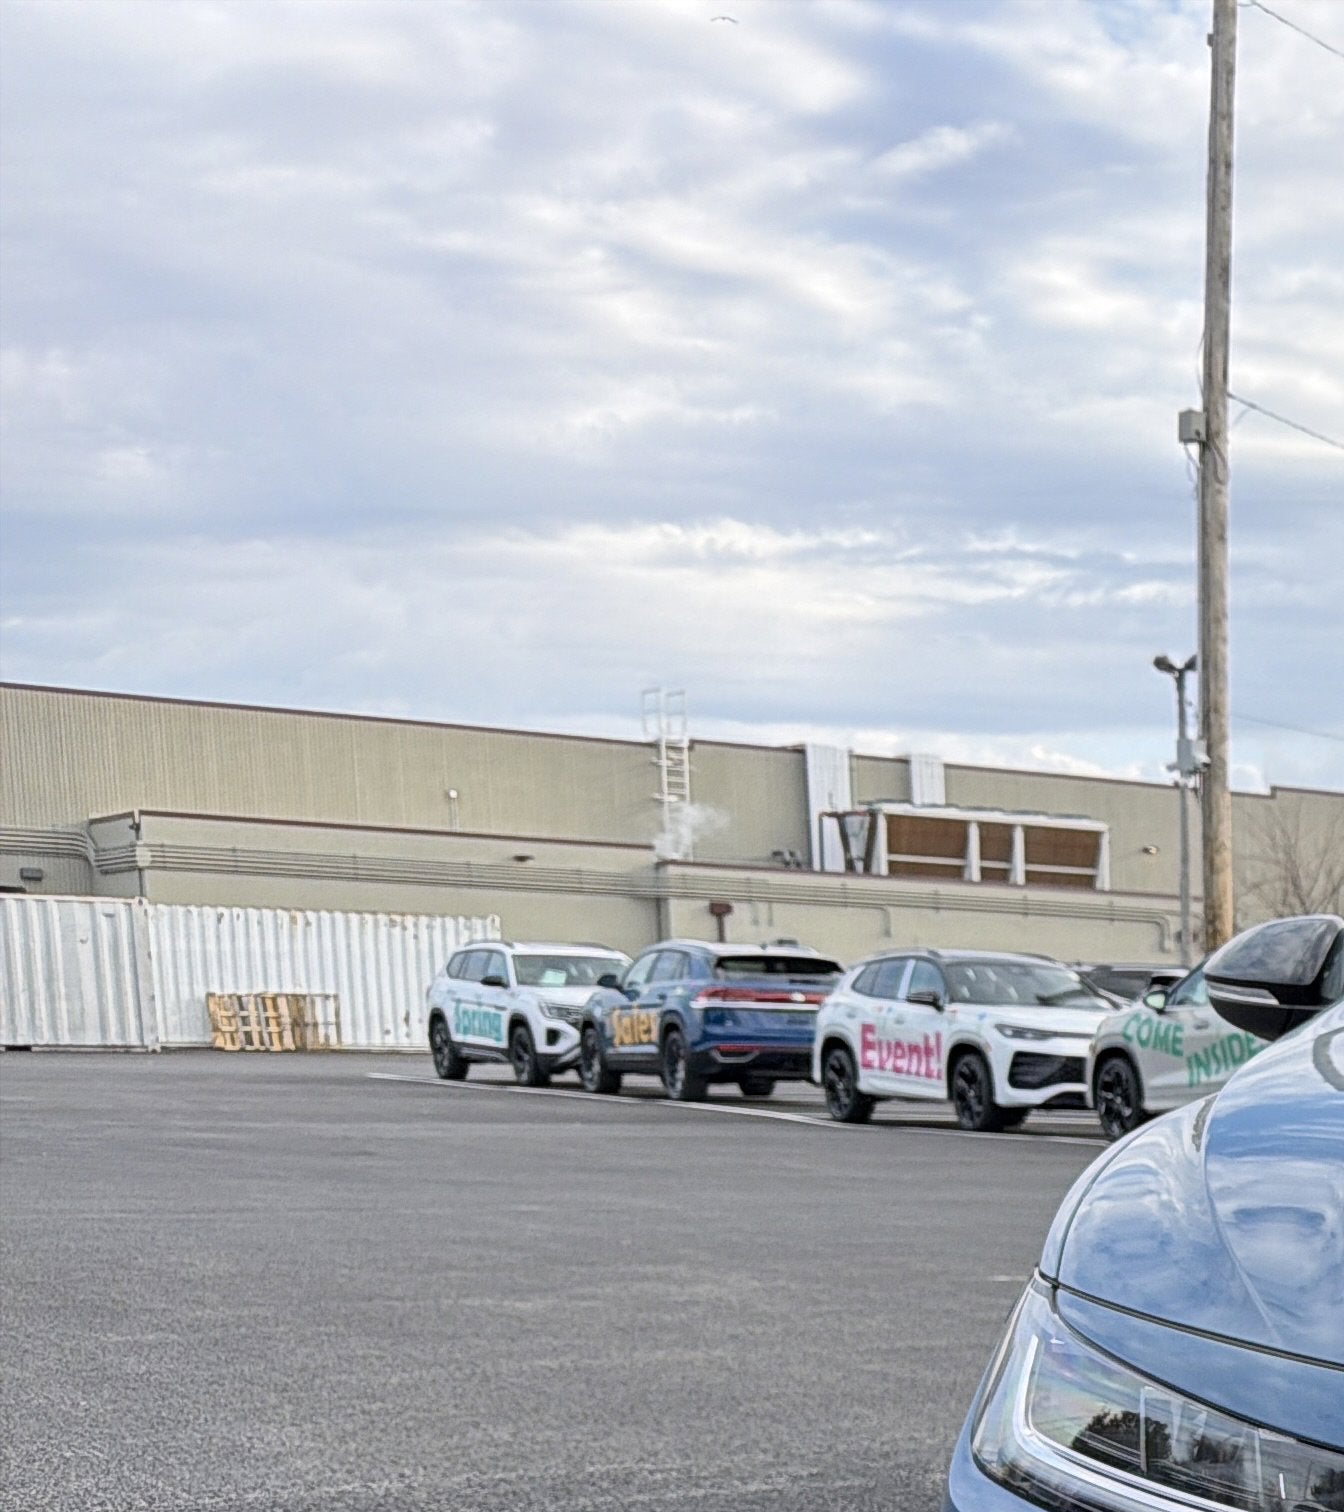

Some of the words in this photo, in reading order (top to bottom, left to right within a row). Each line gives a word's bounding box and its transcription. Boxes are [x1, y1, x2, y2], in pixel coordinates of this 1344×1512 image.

[860, 1023, 943, 1080] Event!
[1122, 1012, 1184, 1057] COME
[1186, 1031, 1266, 1088] INSIDE
